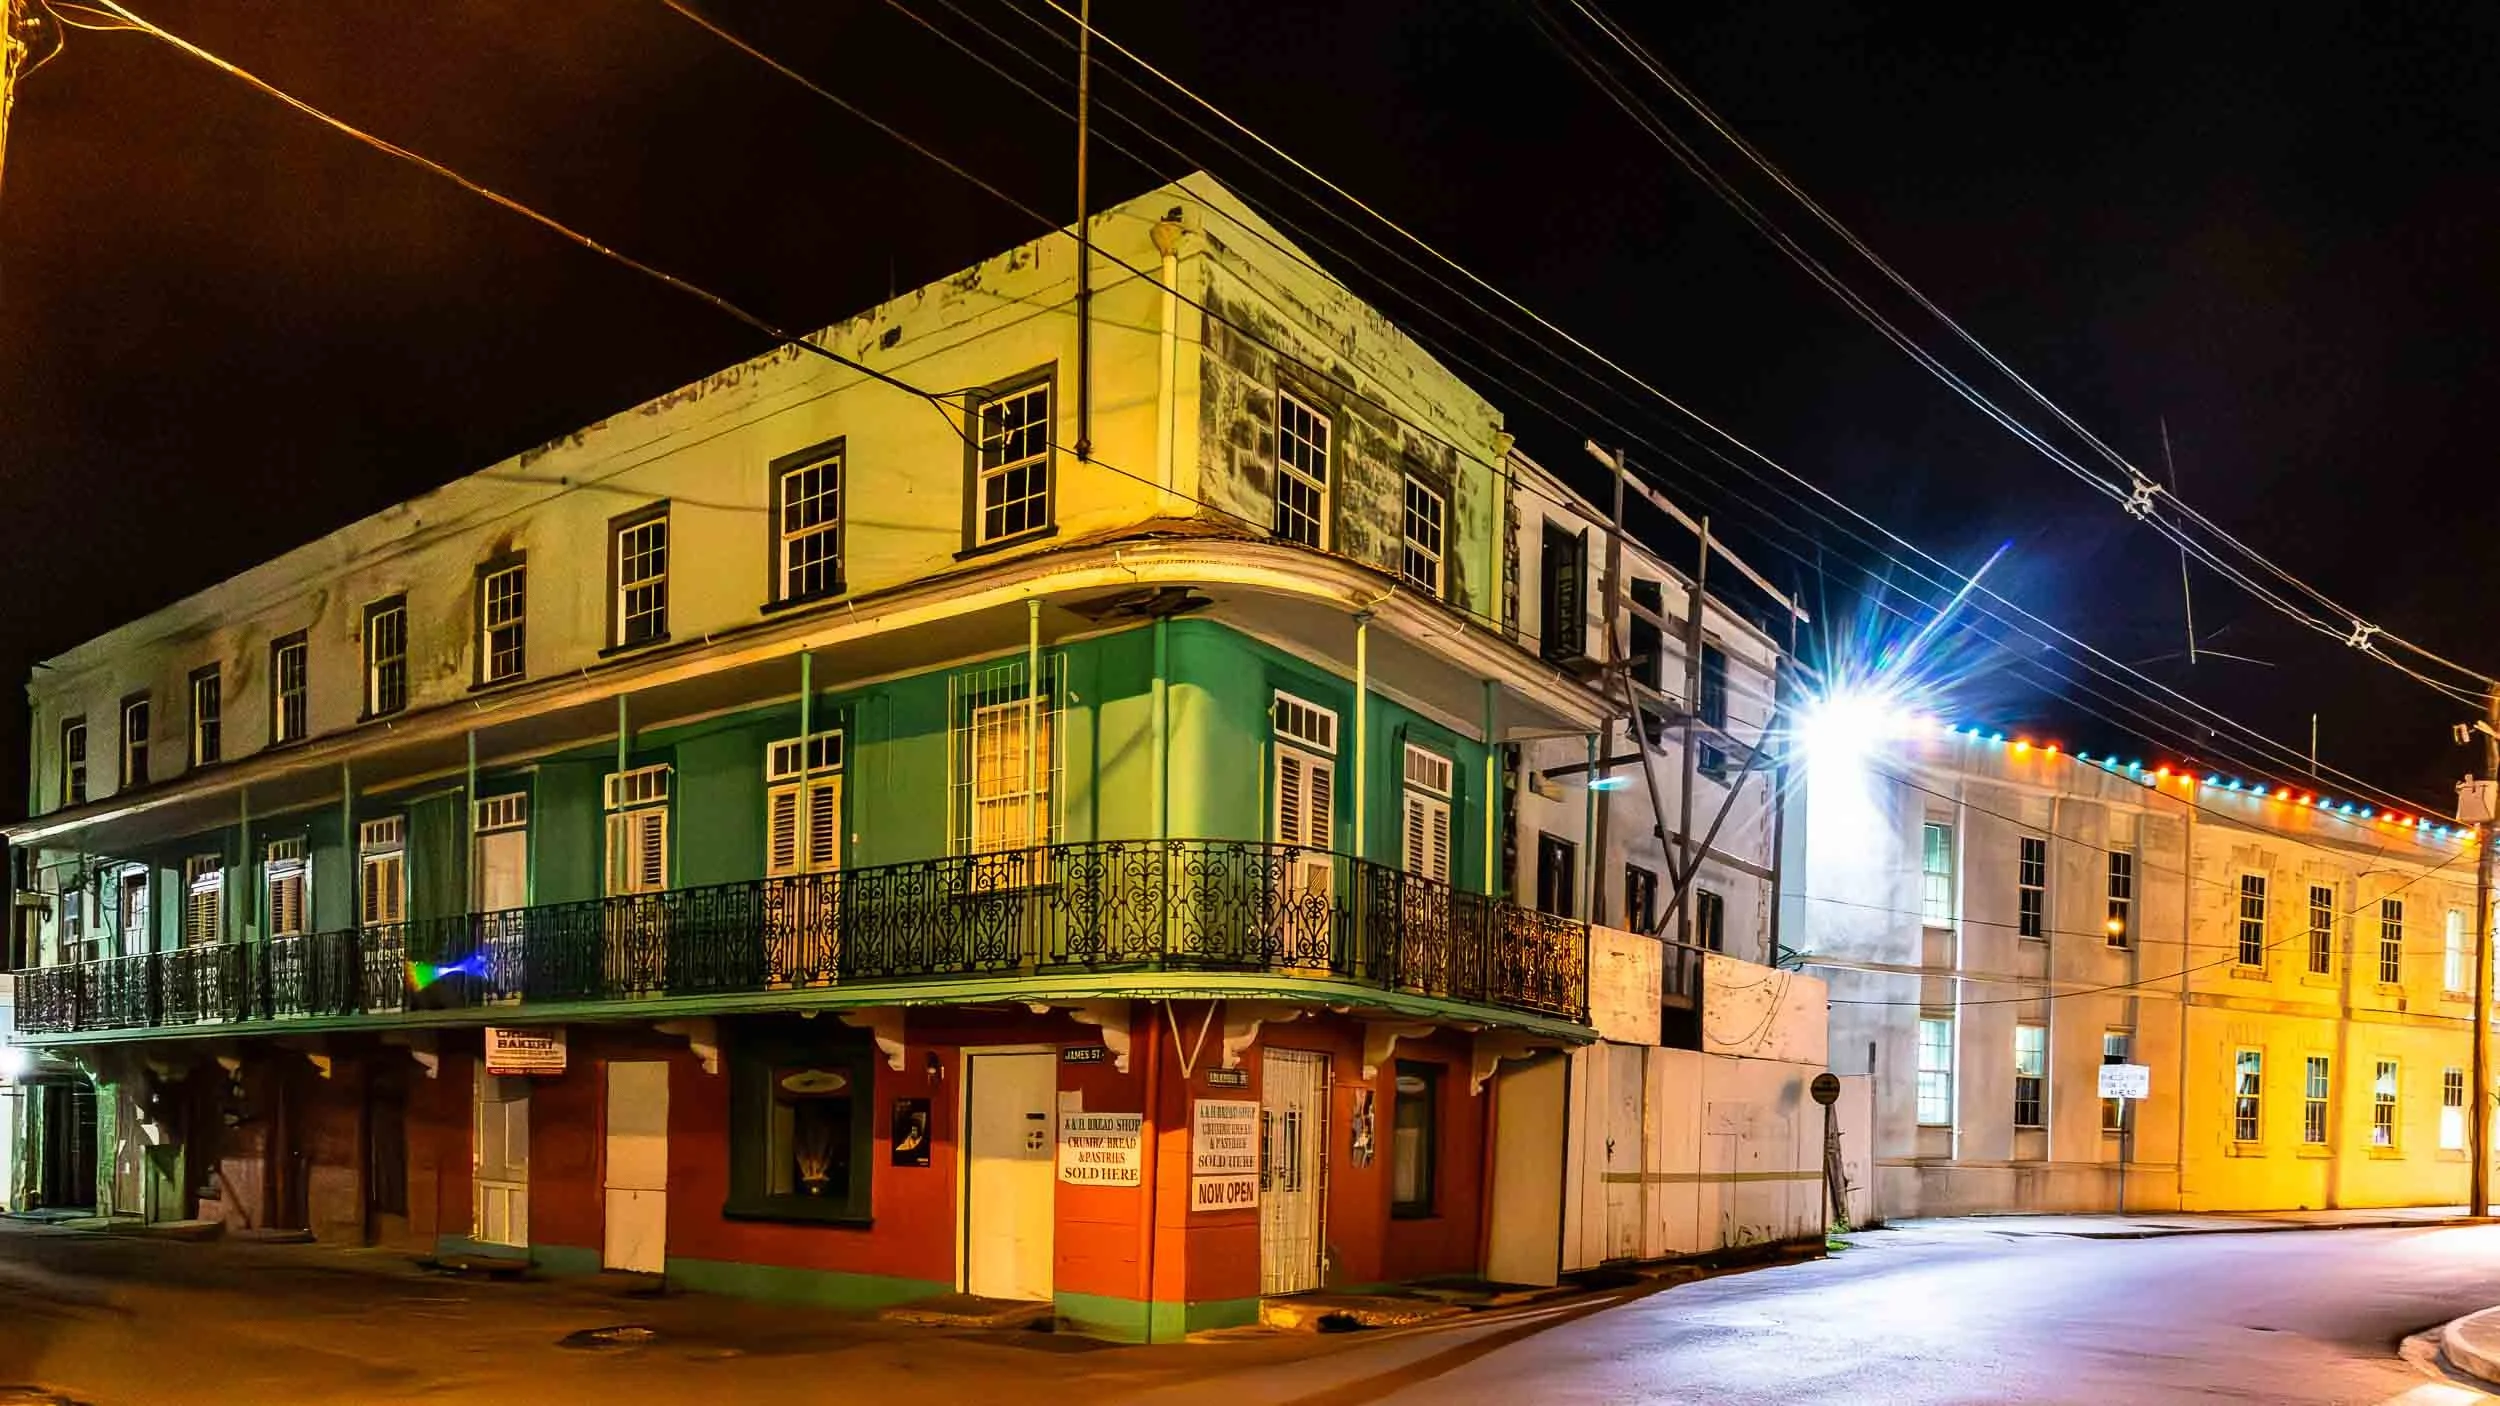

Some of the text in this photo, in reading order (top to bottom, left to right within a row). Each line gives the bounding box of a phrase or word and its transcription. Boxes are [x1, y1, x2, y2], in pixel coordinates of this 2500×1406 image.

[1064, 1050, 1089, 1060] JAMES
[1087, 1118, 1114, 1131] BREAD
[1116, 1118, 1140, 1132] SHOP
[1107, 1136, 1137, 1149] BREAD
[1198, 1154, 1256, 1168] SOLD HERE
[1064, 1167, 1139, 1181] SOLD HERE
[1199, 1181, 1254, 1204] NOW OPEN
